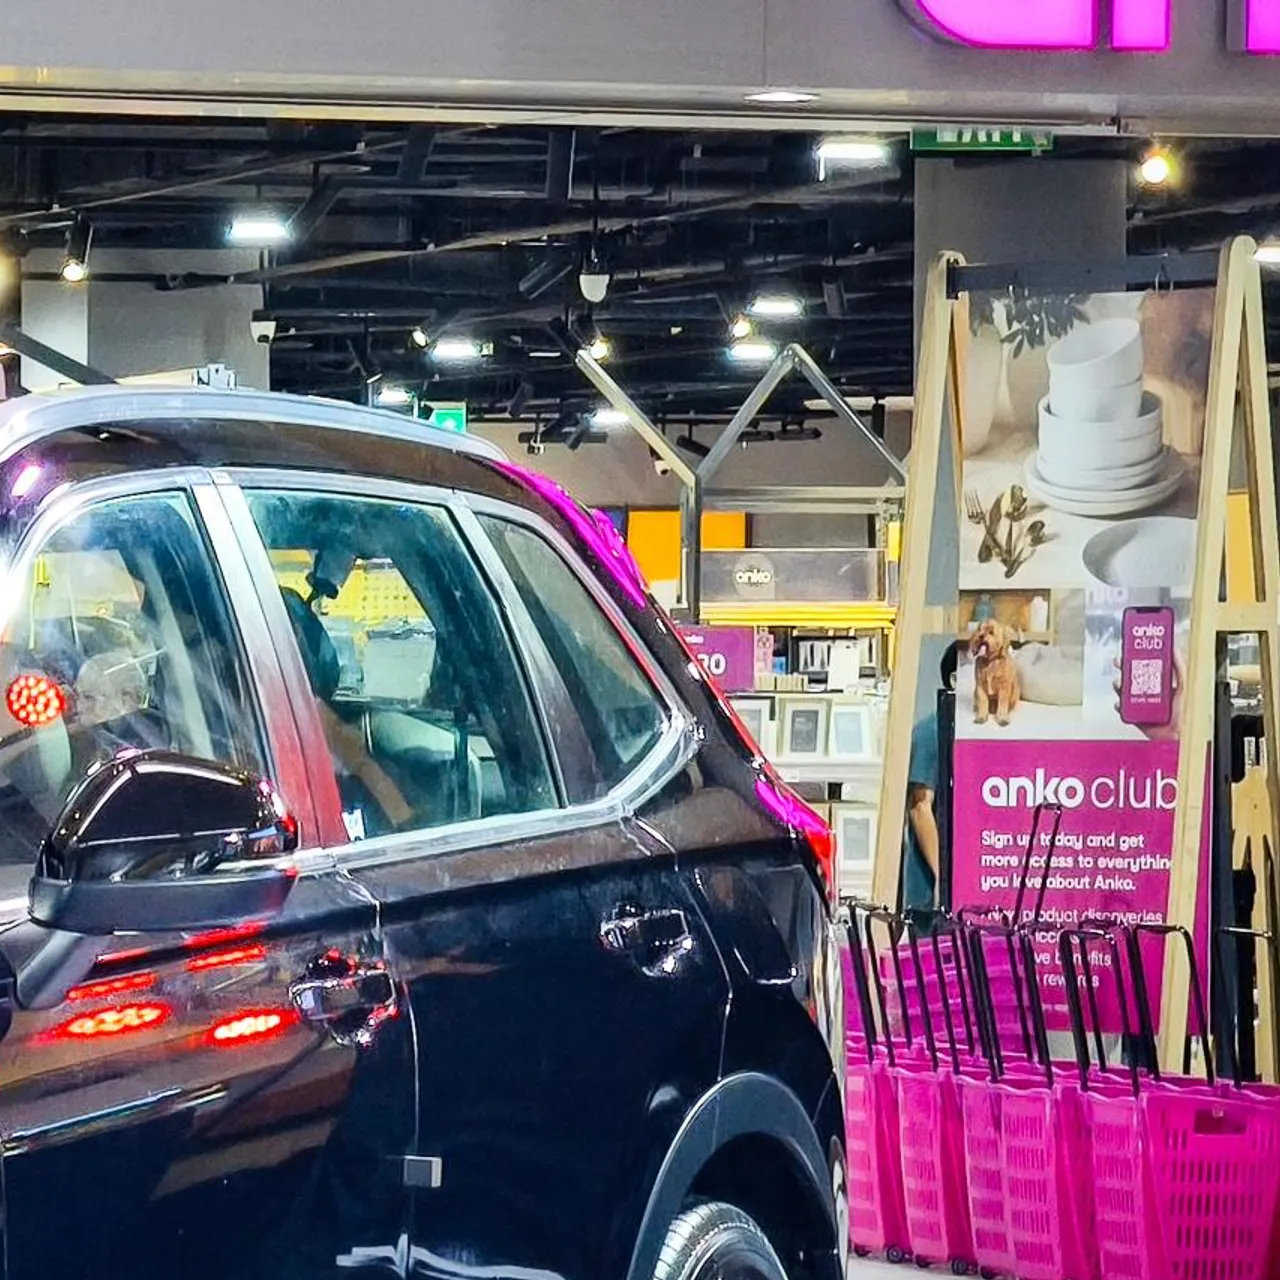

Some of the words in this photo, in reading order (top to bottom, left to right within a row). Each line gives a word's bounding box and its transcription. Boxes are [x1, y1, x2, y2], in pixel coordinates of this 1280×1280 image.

[1132, 624, 1165, 637] anko
[1134, 637, 1163, 650] club
[981, 768, 1085, 808] anko
[1091, 769, 1179, 809] club
[981, 830, 1013, 849] Sign
[1086, 832, 1116, 847] and
[1119, 834, 1145, 851] get
[981, 855, 1019, 868] more
[1077, 855, 1094, 868] to
[1097, 854, 1174, 873] everythin
[981, 875, 1009, 892] you
[1046, 874, 1091, 890] about
